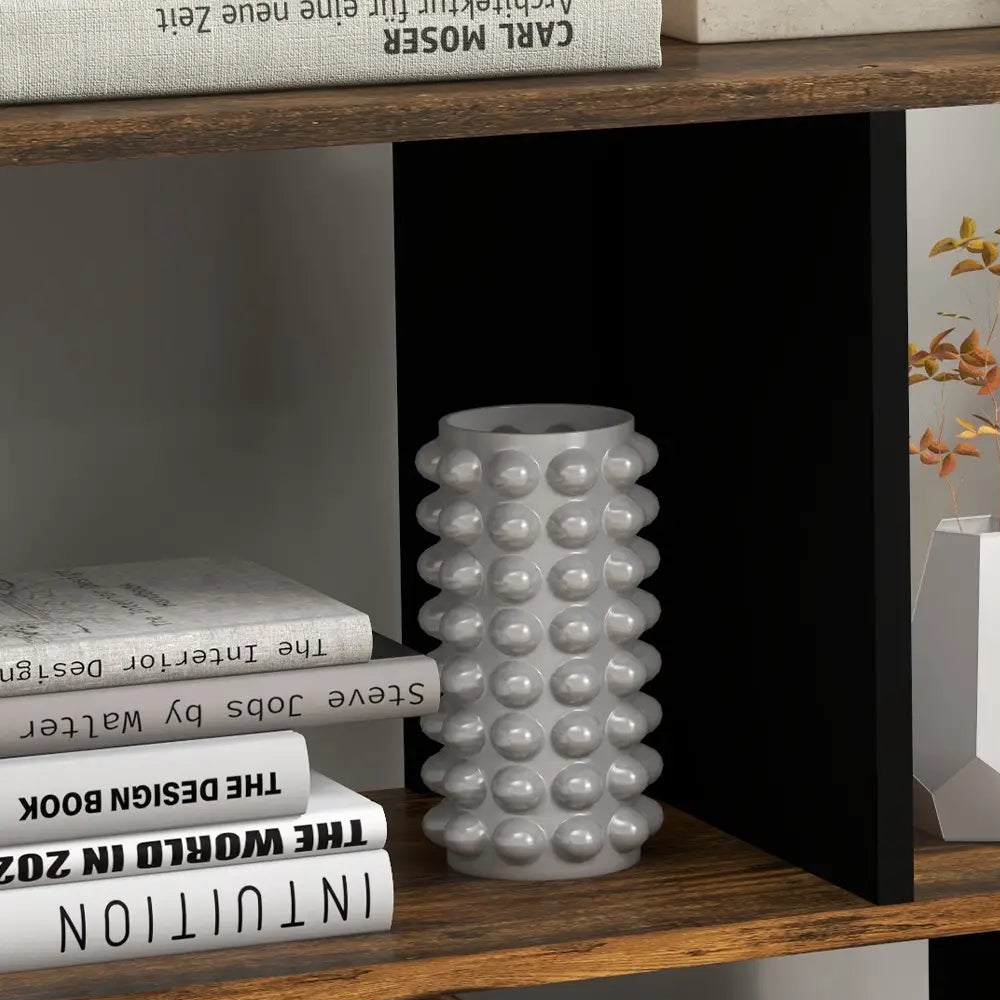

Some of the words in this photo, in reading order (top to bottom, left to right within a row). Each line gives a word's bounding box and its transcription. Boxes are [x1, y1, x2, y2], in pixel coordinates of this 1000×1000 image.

[155, 5, 212, 36] Zeit
[221, 1, 289, 25] neue
[299, 0, 358, 27] eine
[368, 0, 409, 24] für
[383, 24, 486, 56] MOSER
[498, 20, 574, 50] CARL
[122, 644, 258, 673] Interior
[278, 638, 328, 659] The
[0, 659, 102, 685] Design
[226, 694, 304, 722] Jobs
[328, 682, 425, 709] Steve
[19, 710, 143, 740] Walter
[165, 699, 202, 729] by
[110, 777, 219, 812] DESIGN
[226, 771, 282, 800] THE
[18, 789, 102, 822] BOOK
[136, 827, 284, 870] WORLD
[293, 818, 369, 854] THE
[82, 844, 125, 877] IN
[59, 872, 371, 954] INTUITION
